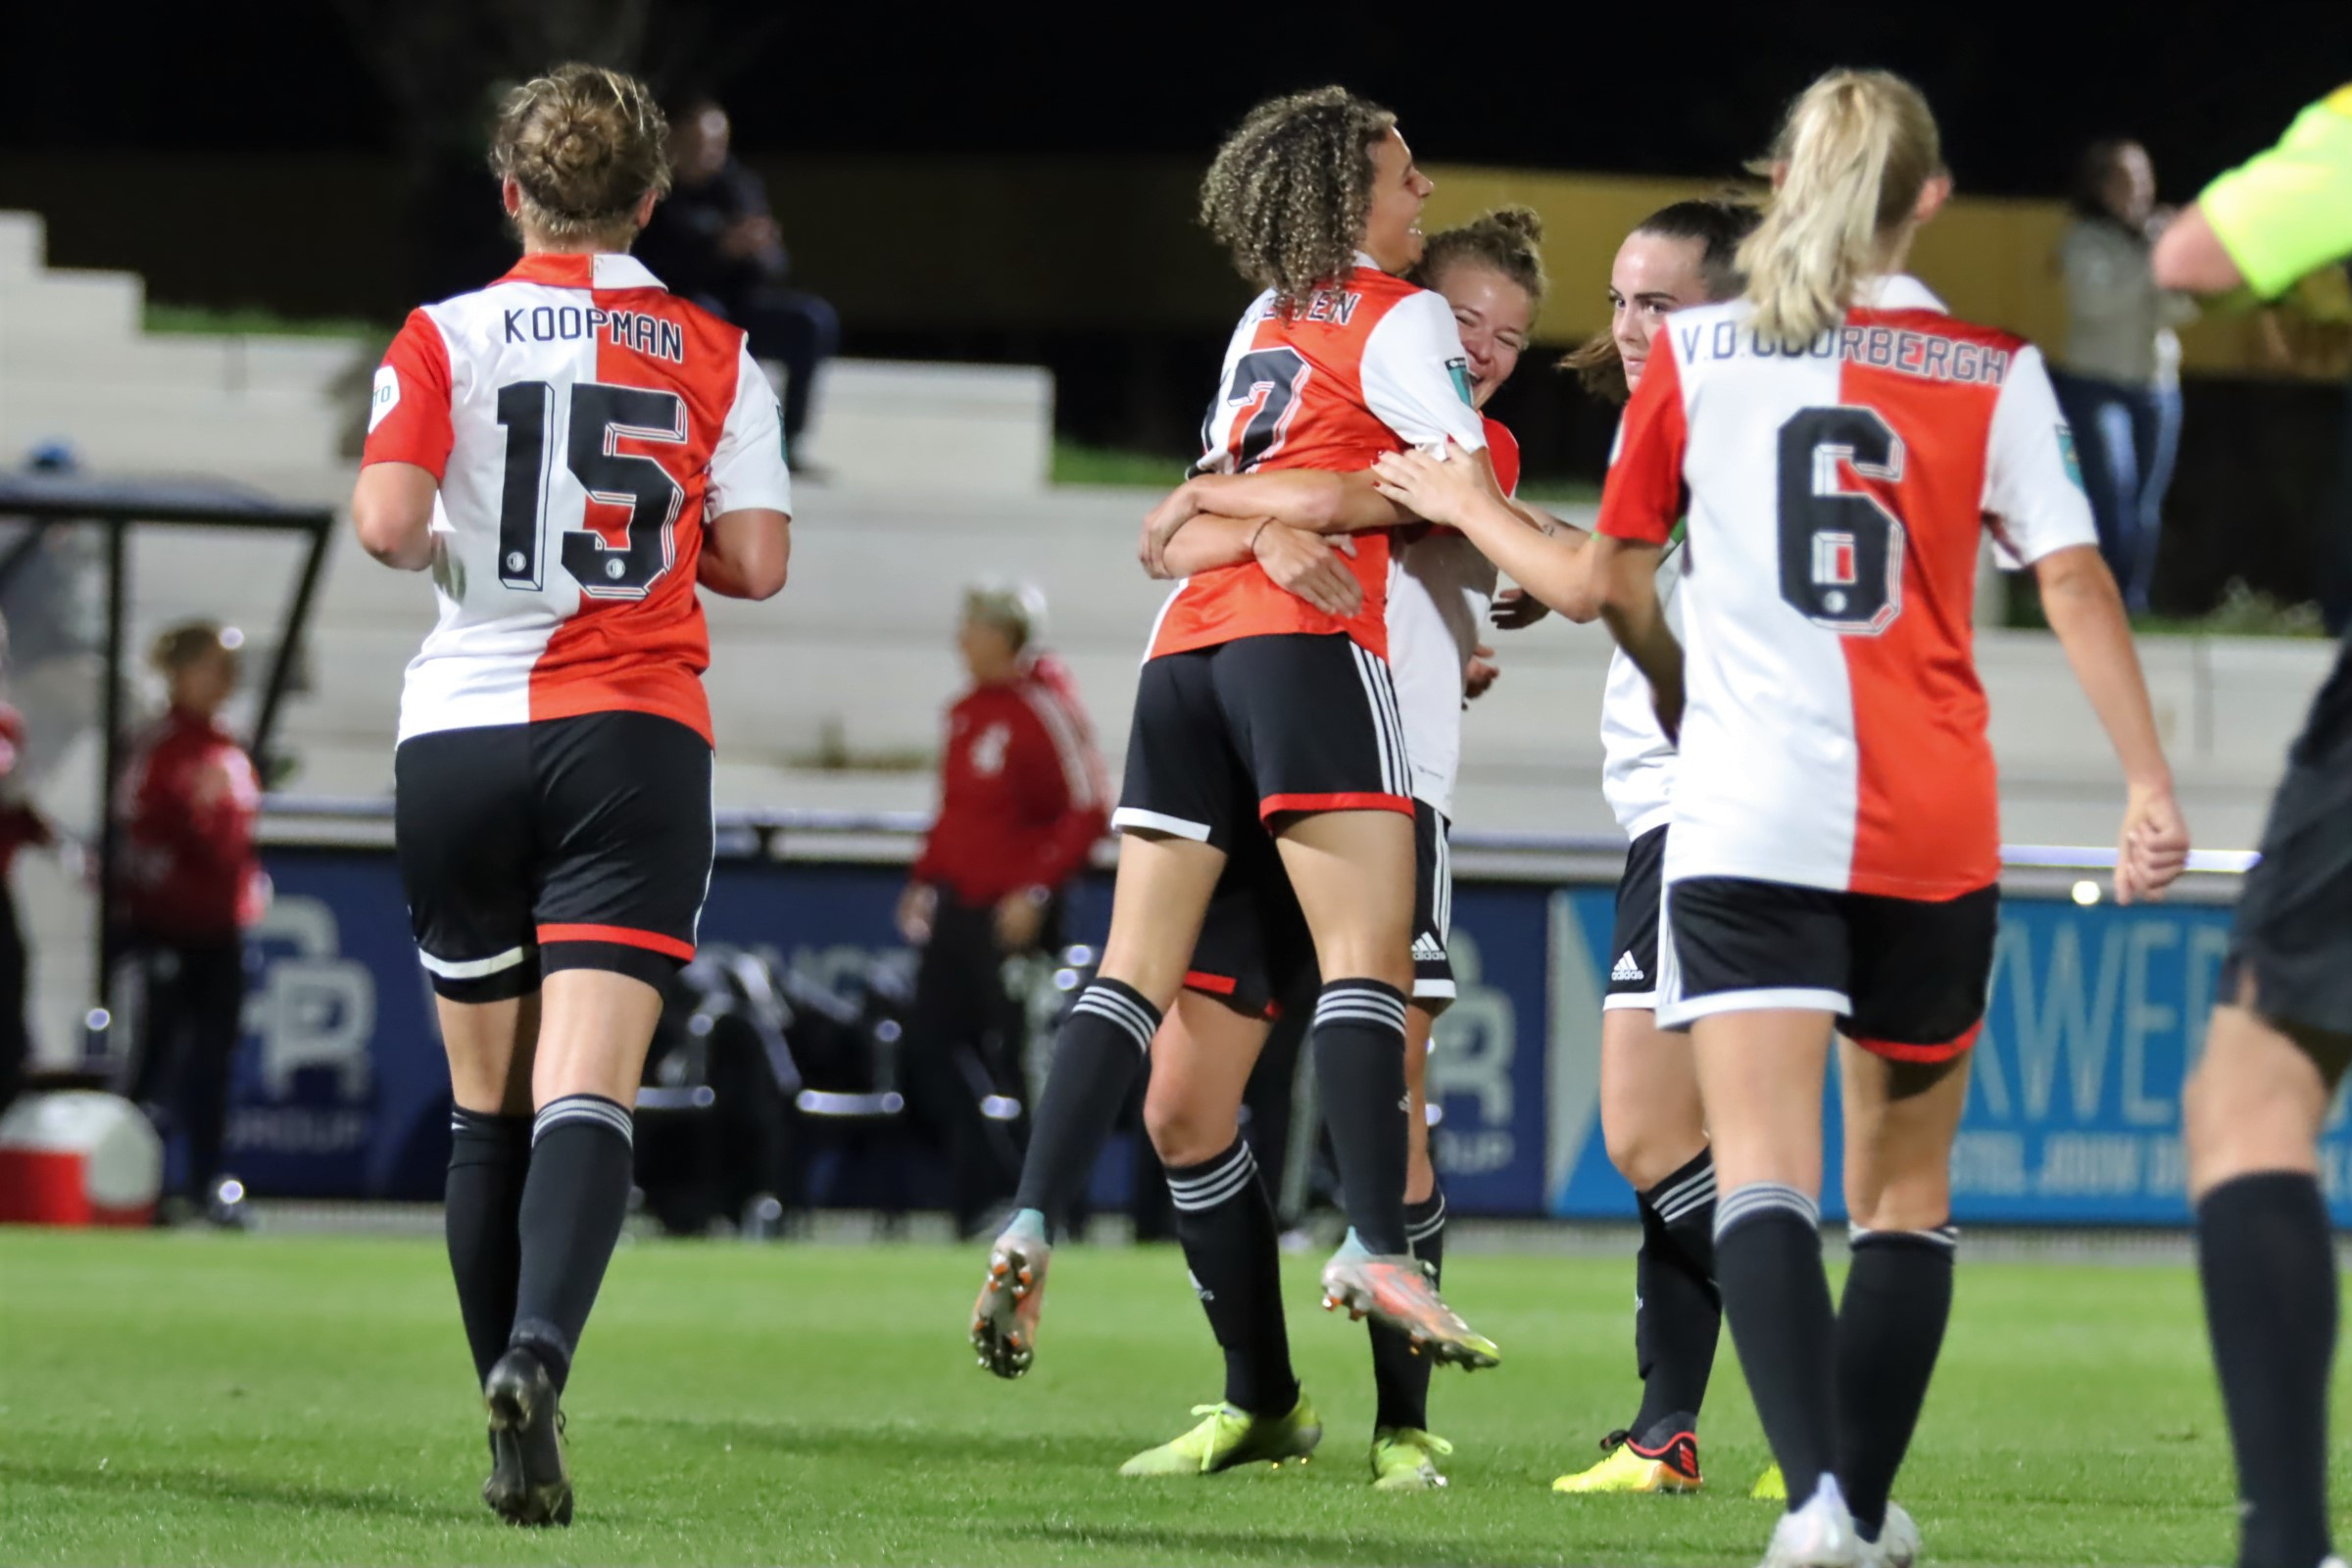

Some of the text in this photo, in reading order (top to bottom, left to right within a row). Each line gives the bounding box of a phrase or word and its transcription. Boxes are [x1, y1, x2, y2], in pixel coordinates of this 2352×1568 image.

[504, 306, 683, 364] KOOPMAN
[497, 380, 688, 600] 15
[1777, 405, 1905, 637] 6
[1611, 968, 1644, 981] adidas
